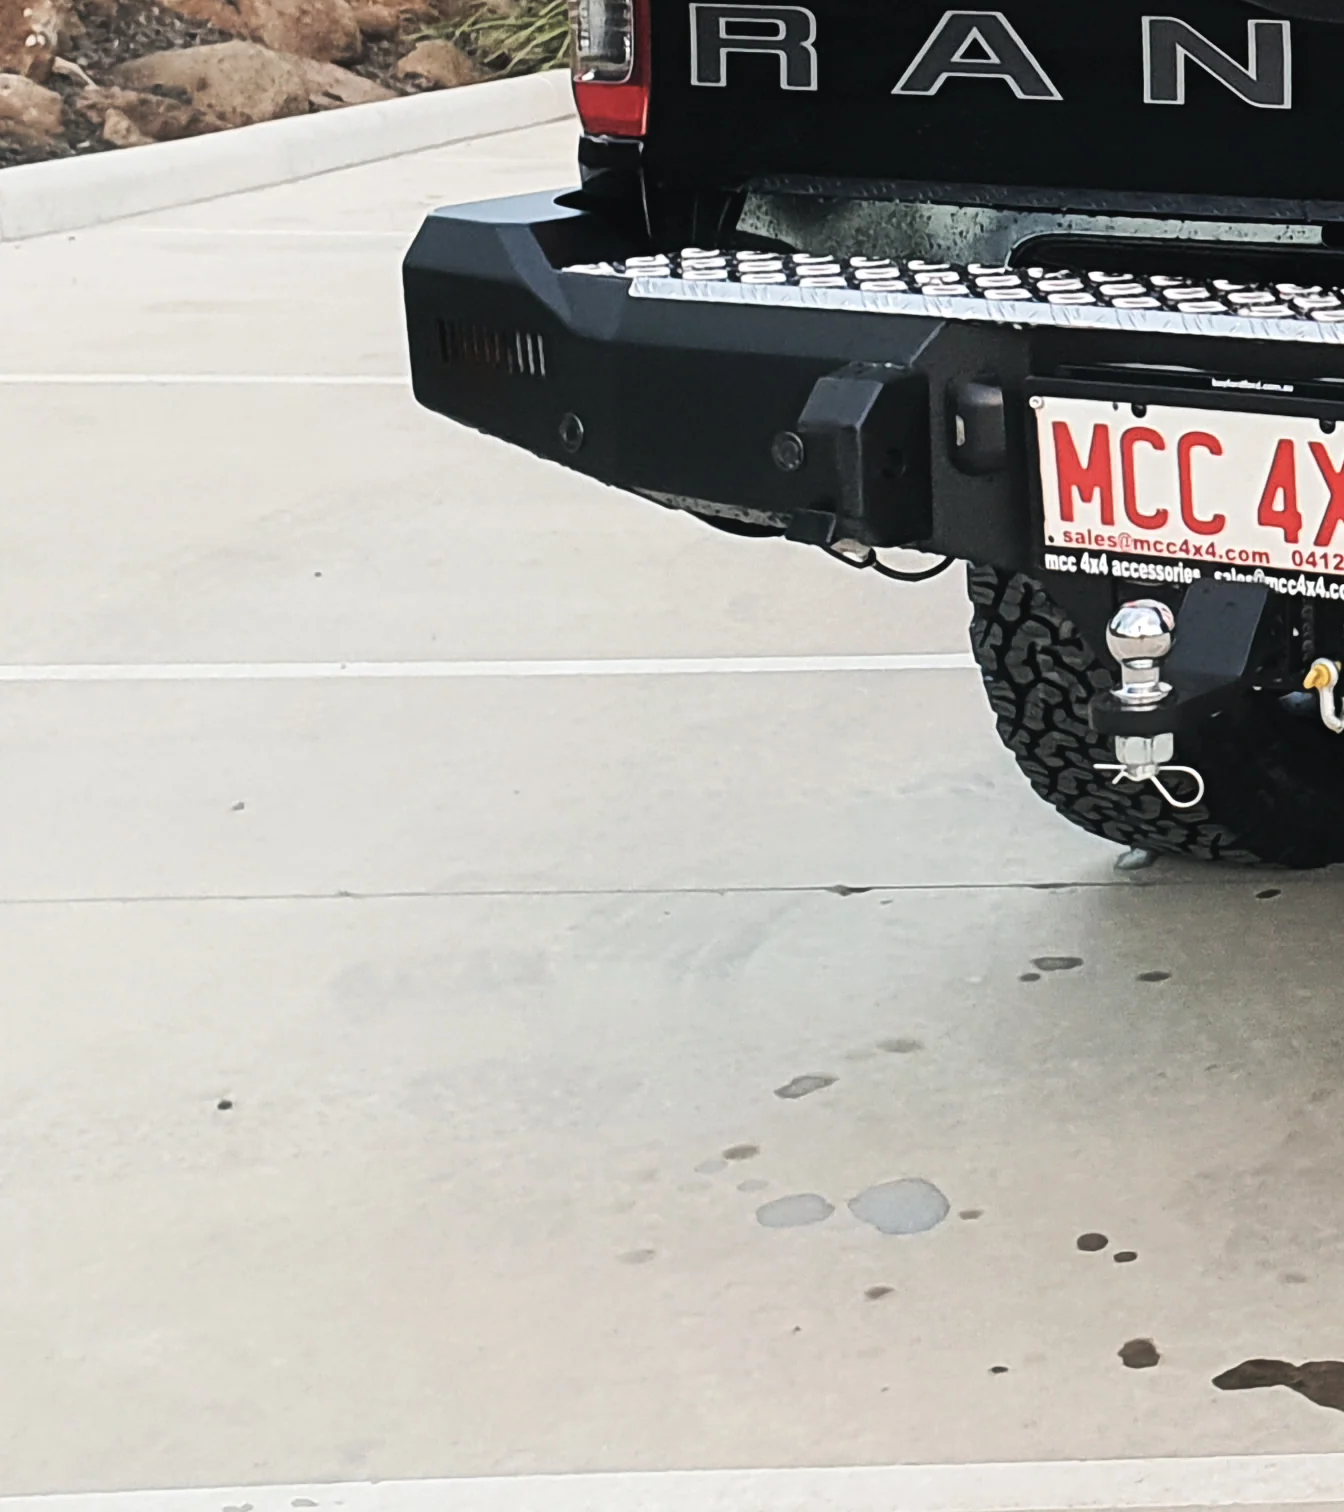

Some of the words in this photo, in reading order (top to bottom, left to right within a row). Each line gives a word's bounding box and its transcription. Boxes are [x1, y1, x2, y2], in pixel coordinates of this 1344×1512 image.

[1052, 420, 1226, 535] MCC
[1045, 553, 1077, 571] mcc
[1080, 552, 1109, 576] 4x4
[1062, 529, 1271, 564] sales@mcc4x4.com
